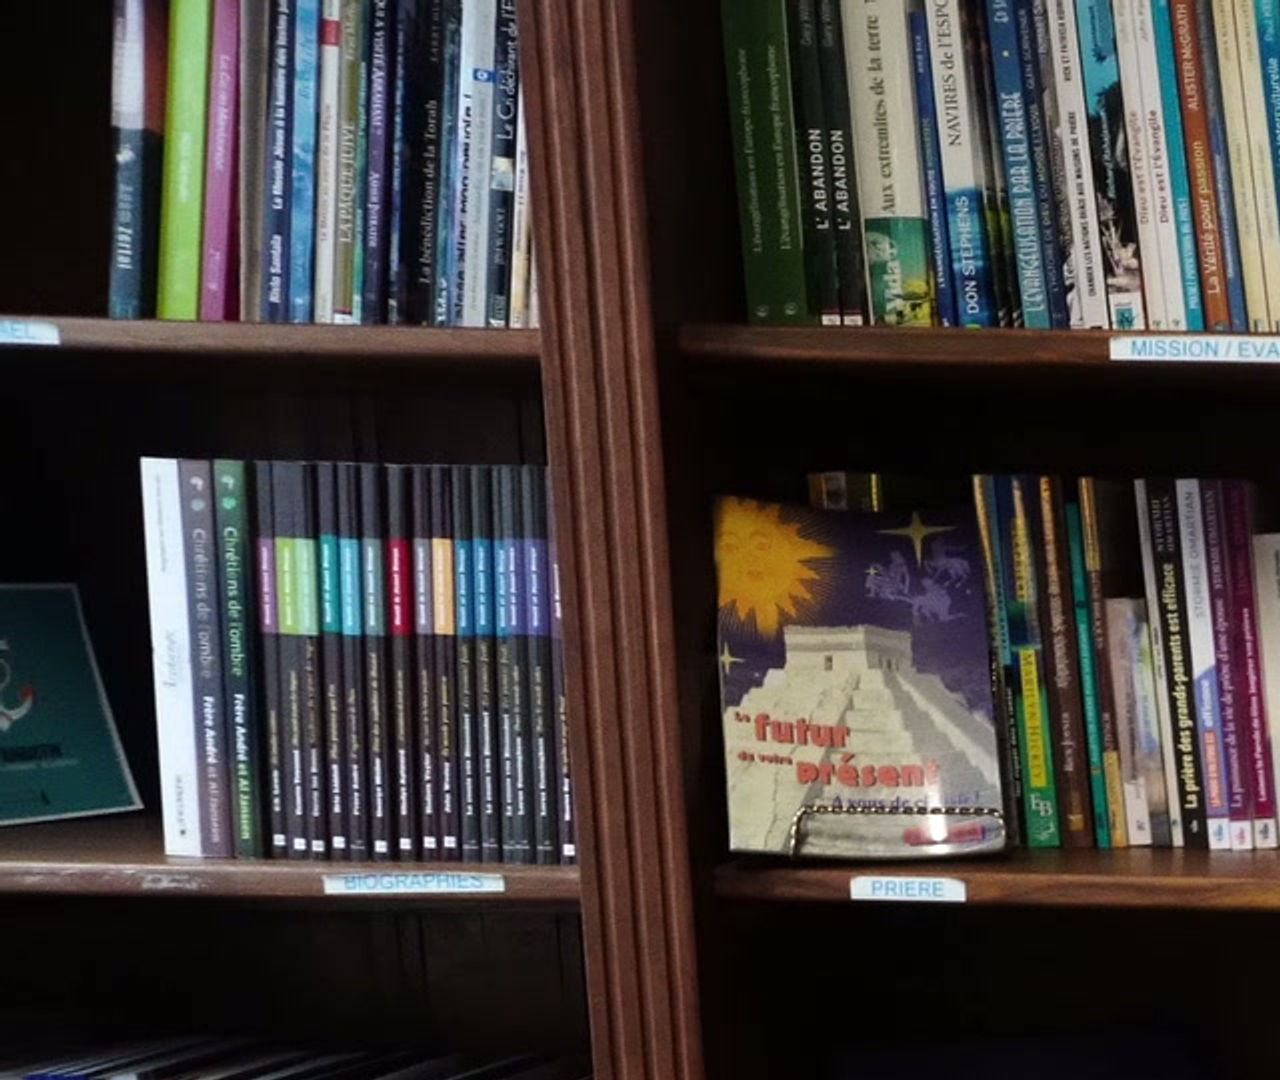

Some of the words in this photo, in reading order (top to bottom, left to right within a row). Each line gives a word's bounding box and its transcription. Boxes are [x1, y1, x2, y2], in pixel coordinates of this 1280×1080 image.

[1176, 3, 1195, 59] McGRATH
[938, 50, 955, 71] de
[1184, 60, 1201, 111] ALISTER
[422, 98, 438, 141] Torah
[940, 74, 963, 146] NAVIRES
[421, 143, 436, 157] la
[1192, 139, 1210, 194] passion
[421, 159, 435, 179] de
[808, 127, 827, 212] ABANDON
[830, 128, 849, 213] ABANDON
[1199, 197, 1215, 230] pour
[954, 195, 976, 276] STEPHENS
[1199, 230, 1220, 274] Vérité
[418, 267, 432, 283] La
[1207, 274, 1221, 294] La
[964, 279, 980, 314] DON
[1130, 339, 1219, 358] MISSION
[1161, 562, 1179, 611] efficace
[1167, 612, 1182, 632] est
[1170, 634, 1195, 730] grands-parents
[754, 713, 851, 749] futur
[1178, 730, 1193, 752] des
[1178, 754, 1200, 792] prière
[1183, 792, 1198, 809] La
[343, 872, 485, 891] BIOGRAPHIES
[871, 880, 945, 898] PRIERE
